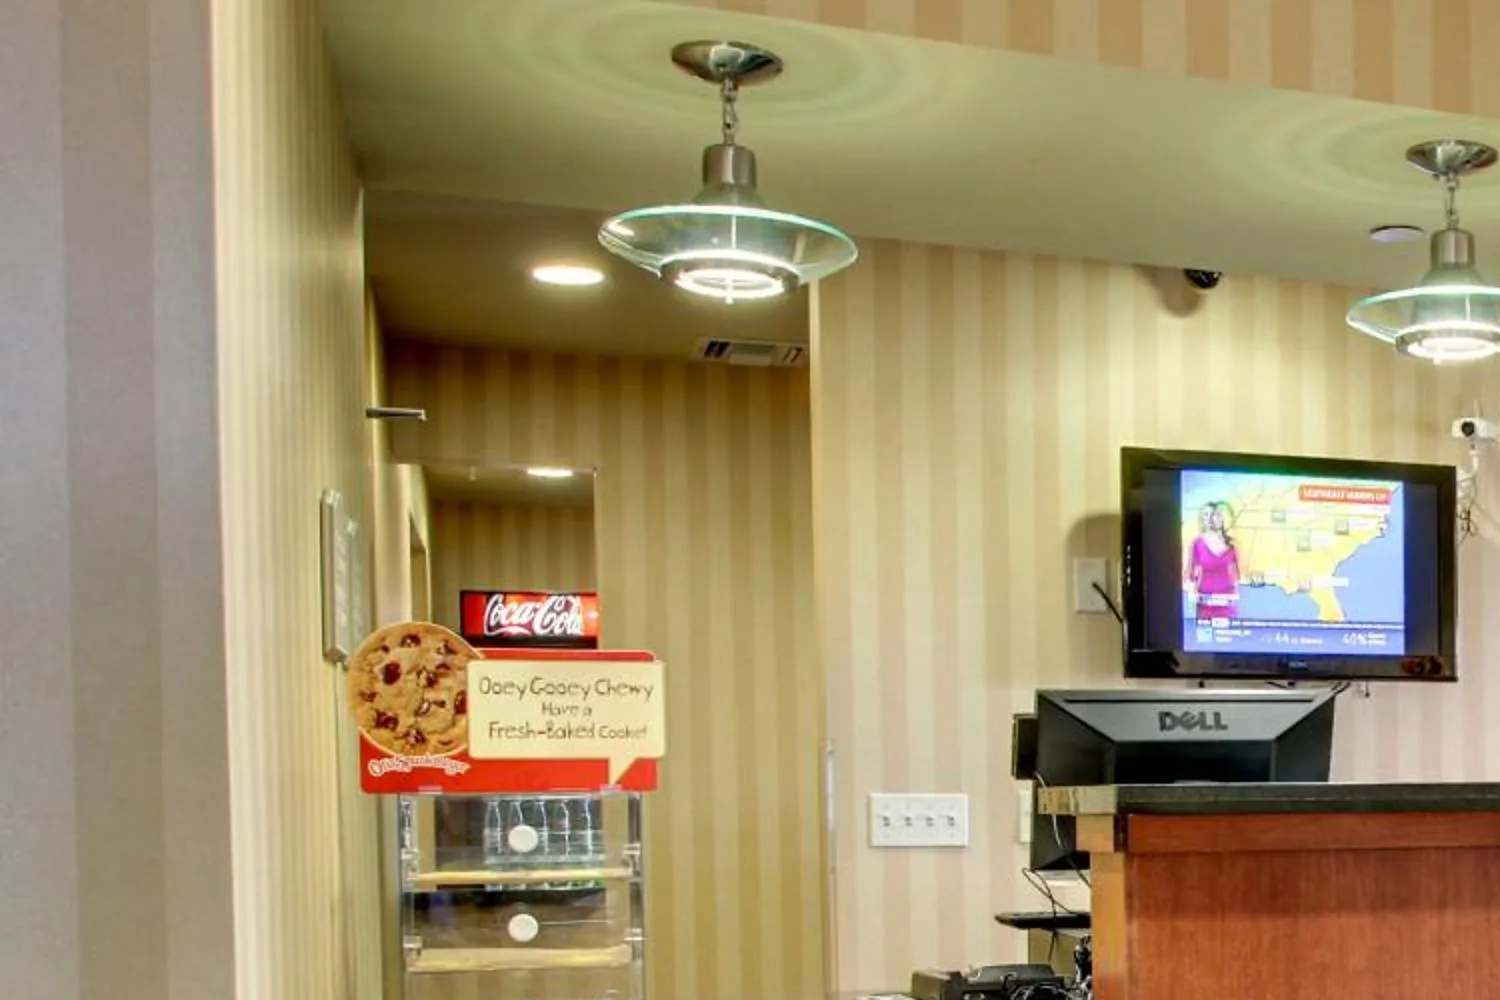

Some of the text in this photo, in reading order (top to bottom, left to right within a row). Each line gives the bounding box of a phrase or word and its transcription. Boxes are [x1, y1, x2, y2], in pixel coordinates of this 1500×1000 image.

[484, 593, 584, 636] Coca-Cola
[479, 677, 655, 700] Ooey Gooey Chewy
[541, 702, 593, 716] Have a
[1159, 711, 1228, 731] DELL
